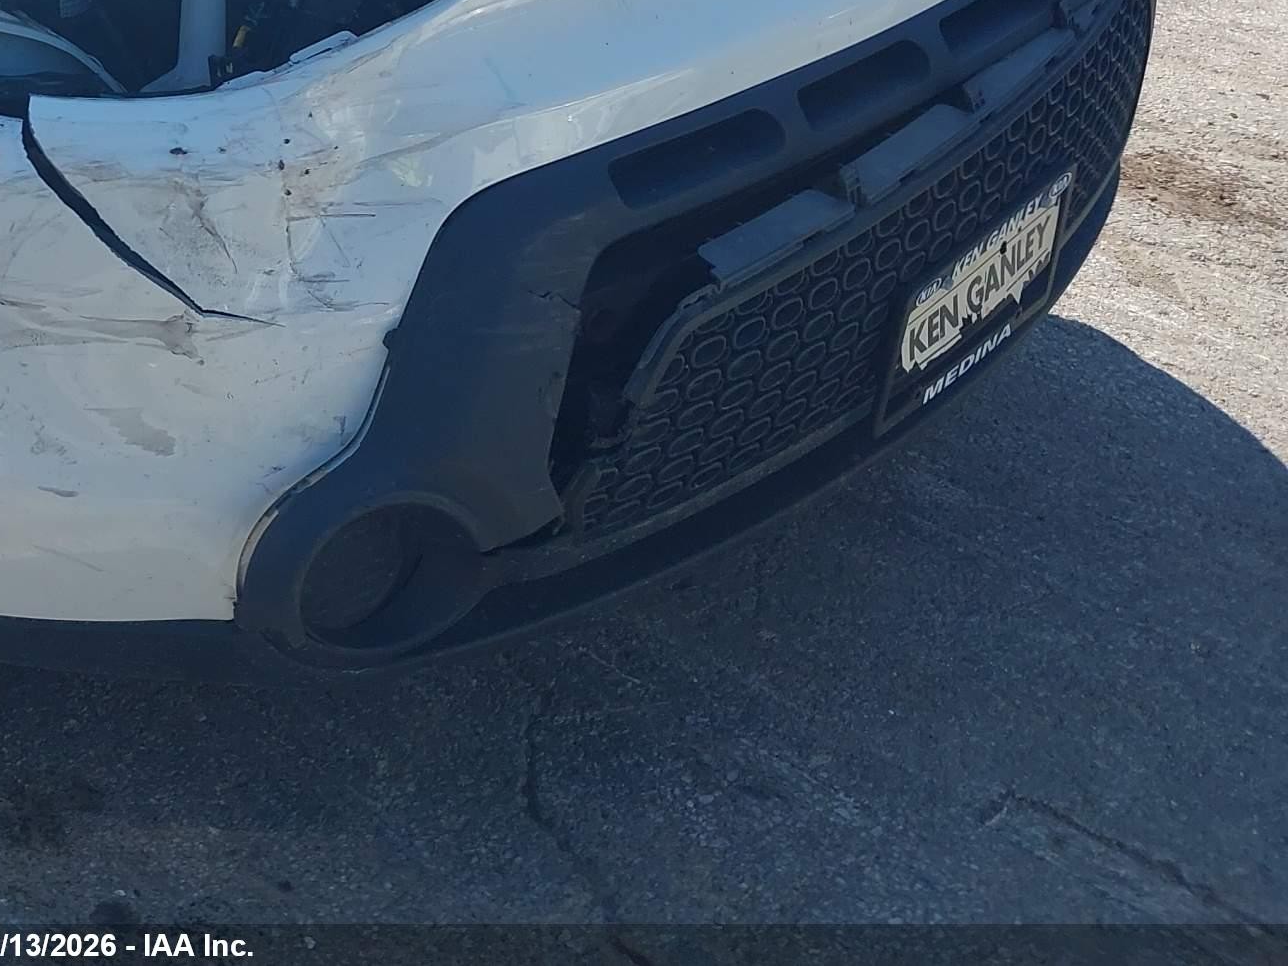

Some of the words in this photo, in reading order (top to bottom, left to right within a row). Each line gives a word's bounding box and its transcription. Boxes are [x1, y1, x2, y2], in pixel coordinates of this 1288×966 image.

[952, 241, 983, 280] KEN
[986, 192, 1044, 249] GANLEY
[909, 294, 959, 362] KEN
[966, 216, 1050, 314] GANLEY
[922, 323, 1012, 405] MEDINA
